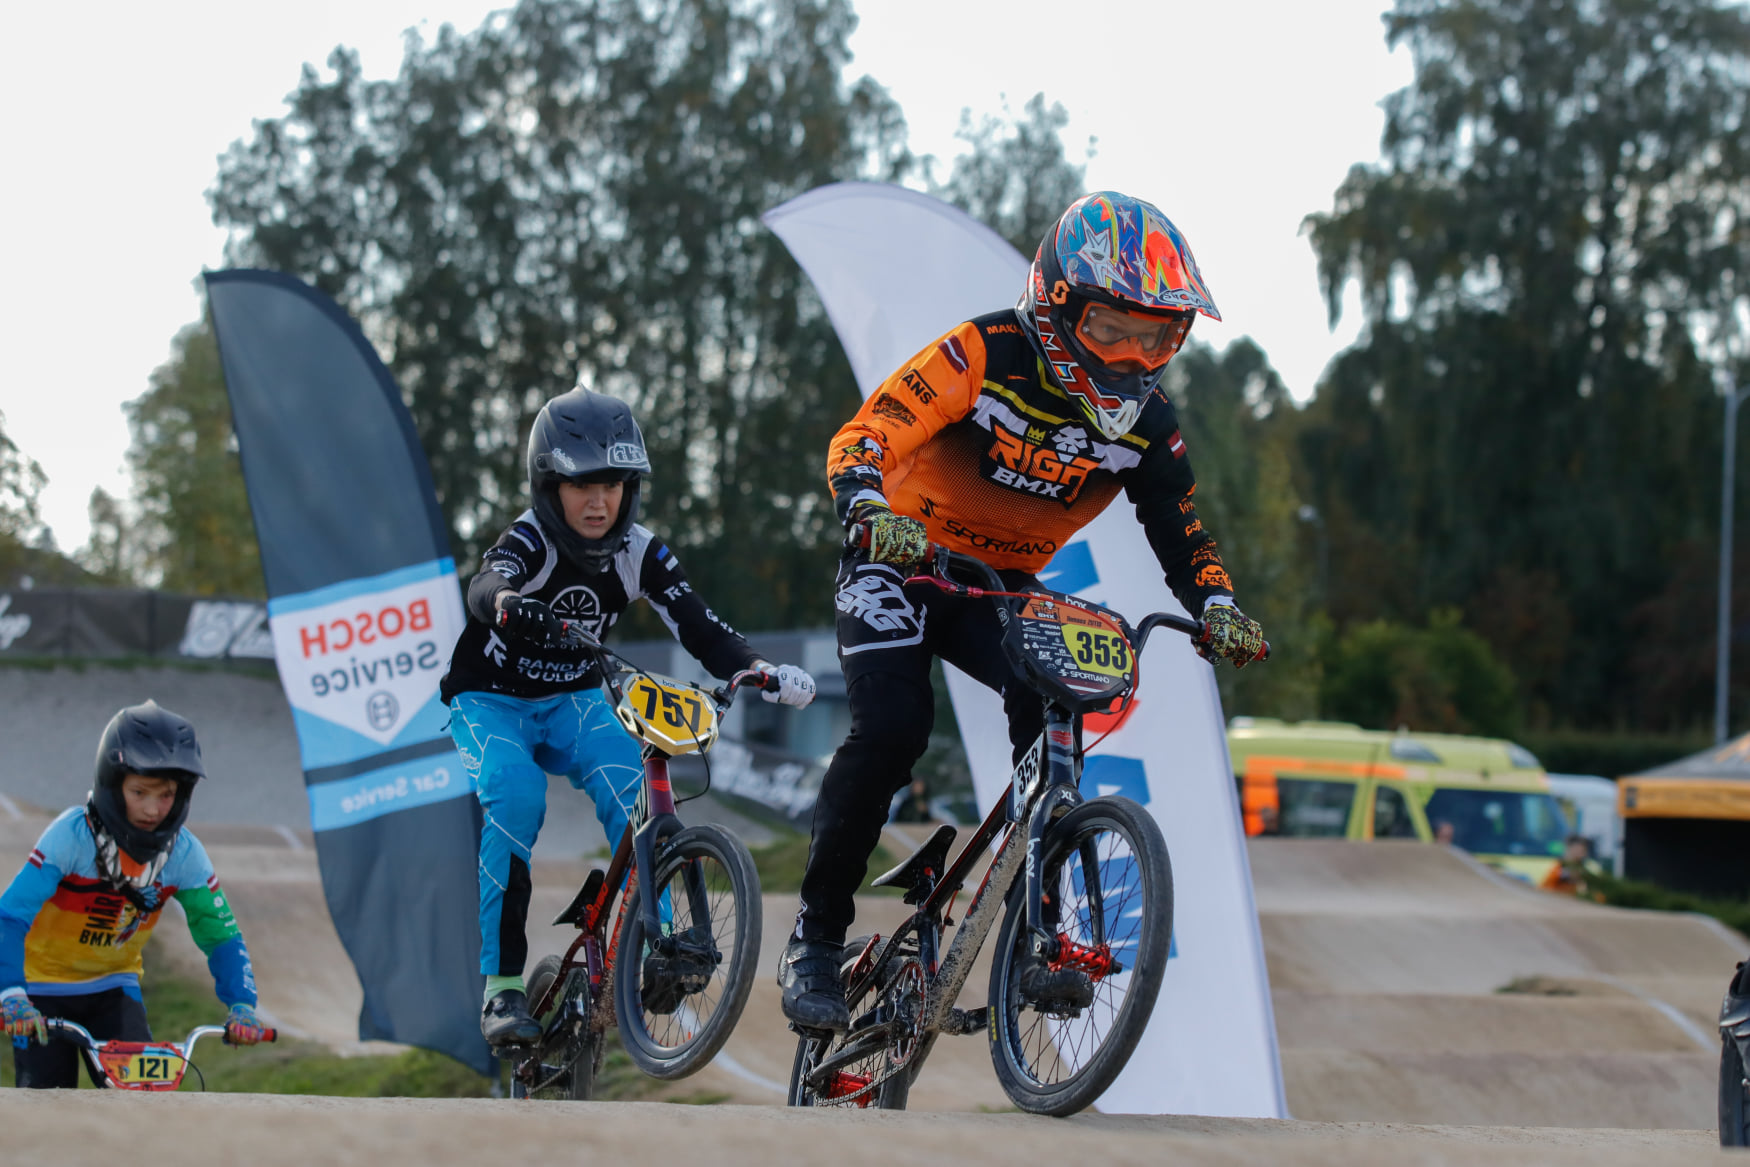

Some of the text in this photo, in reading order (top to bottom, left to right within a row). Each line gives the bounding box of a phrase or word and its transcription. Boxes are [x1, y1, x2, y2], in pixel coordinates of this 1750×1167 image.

[988, 424, 1100, 503] RIGA
[991, 466, 1064, 498] BMX
[941, 520, 1056, 555] SPORTLAND
[517, 656, 574, 672] RAND
[1076, 631, 1128, 671] 353
[662, 679, 677, 689] box
[1070, 670, 1110, 684] SPORTLAND
[639, 684, 702, 734] 757
[1017, 746, 1039, 796] 353
[1060, 789, 1076, 802] XL
[79, 929, 115, 947] BMX
[138, 1057, 169, 1079] 121
